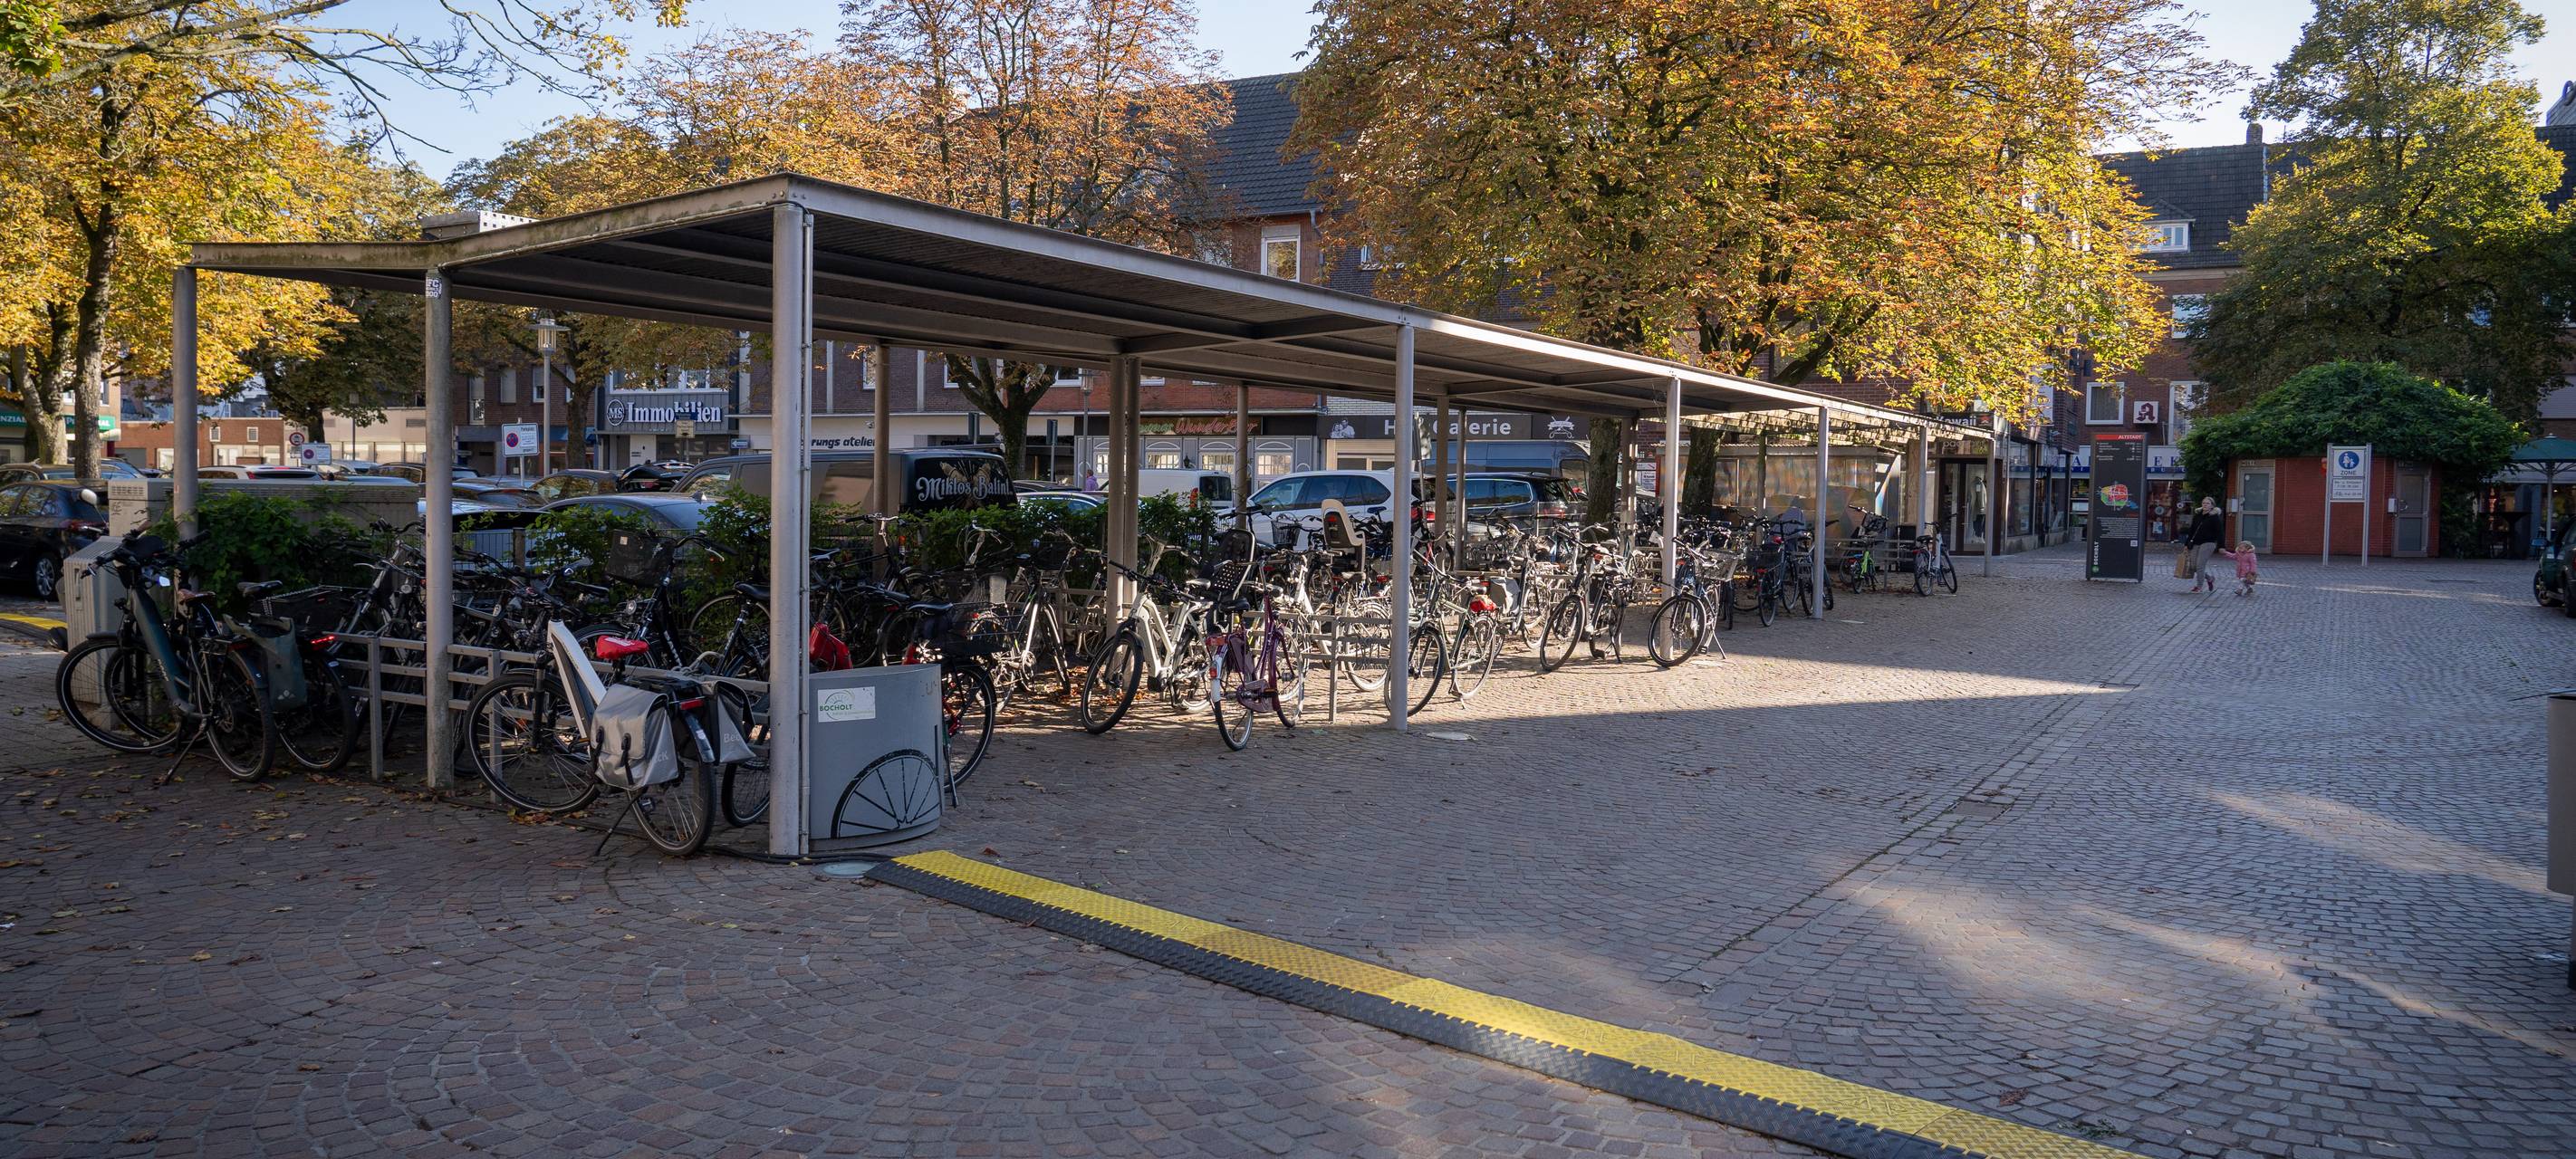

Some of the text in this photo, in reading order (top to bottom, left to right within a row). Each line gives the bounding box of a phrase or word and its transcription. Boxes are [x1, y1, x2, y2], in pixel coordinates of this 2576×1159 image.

[609, 407, 624, 419] MS
[1432, 418, 1512, 435] aerie
[819, 704, 854, 712] BOCHOLT
